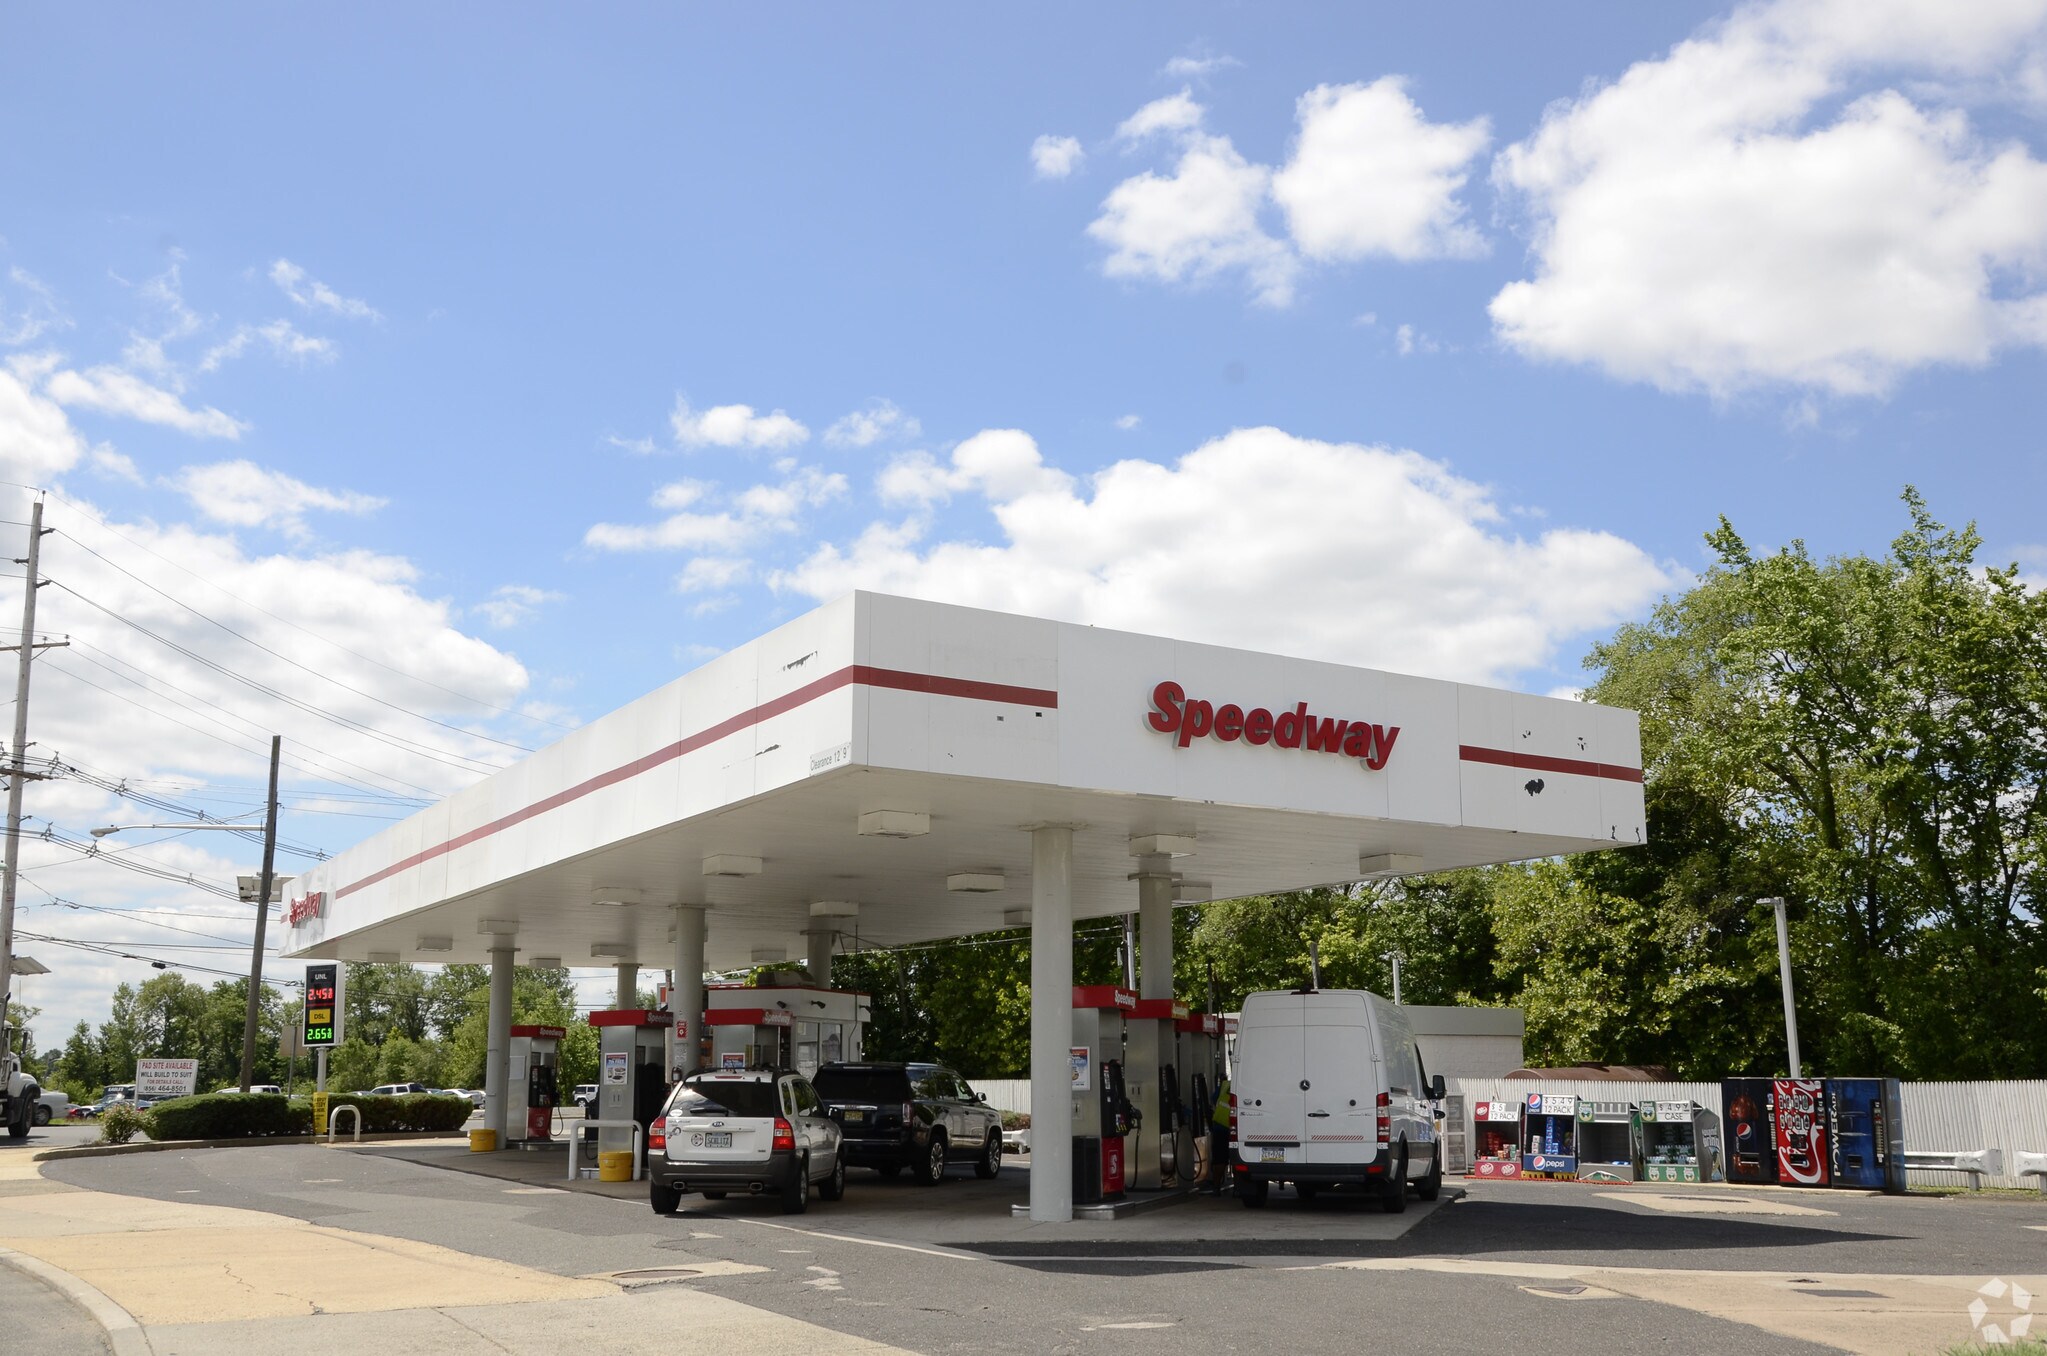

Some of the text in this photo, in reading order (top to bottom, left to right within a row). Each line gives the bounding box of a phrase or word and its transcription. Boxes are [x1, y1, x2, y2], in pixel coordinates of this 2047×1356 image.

[1147, 681, 1401, 771] Speedway
[1115, 989, 1136, 1009] Speedway
[764, 1011, 790, 1025] Speedway
[539, 1027, 564, 1038] Speedway
[165, 1062, 193, 1070] AVAILABLE
[1665, 1112, 1683, 1121] CASE
[1545, 1160, 1565, 1168] pepsi
